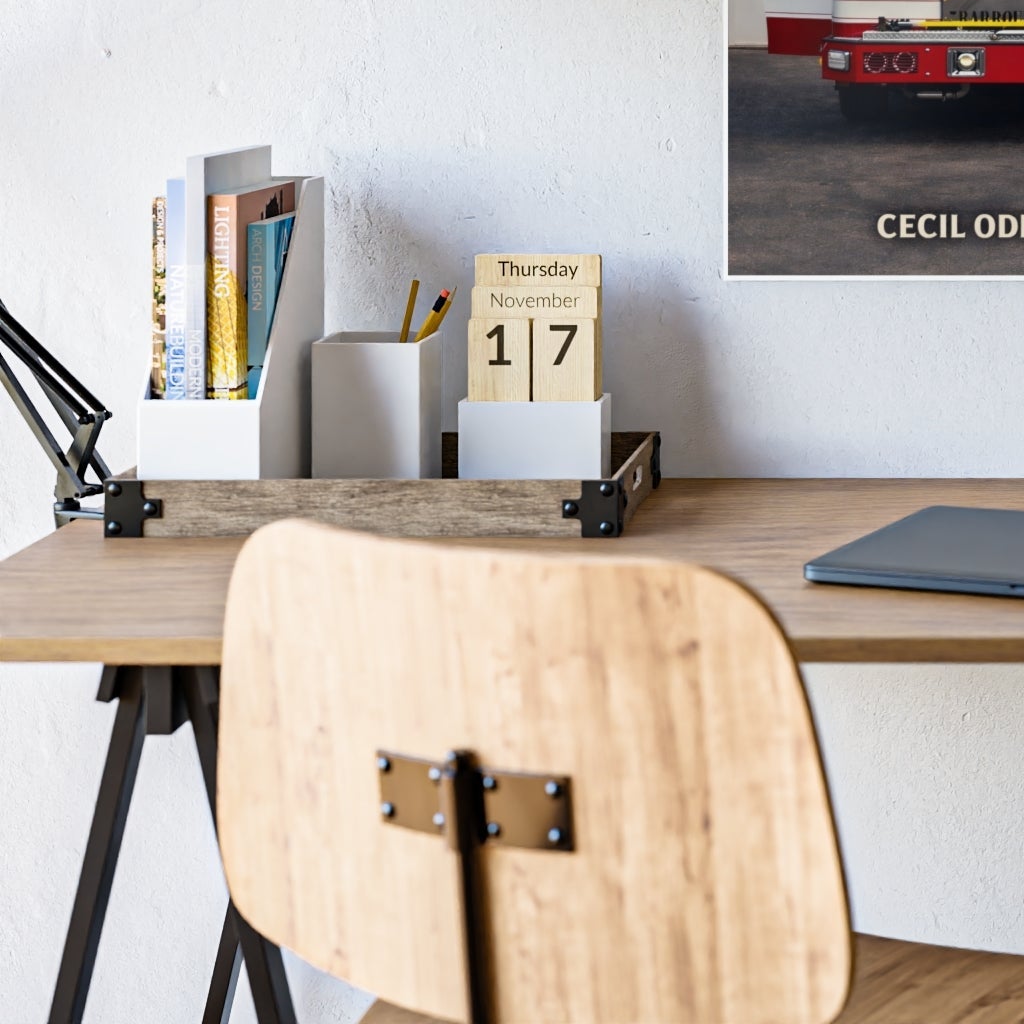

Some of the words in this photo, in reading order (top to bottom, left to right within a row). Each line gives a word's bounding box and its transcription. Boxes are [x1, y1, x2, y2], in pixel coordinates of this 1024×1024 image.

[876, 212, 966, 240] CECIL
[213, 205, 230, 299] LIGHTING
[251, 229, 263, 263] ARCH
[497, 260, 579, 280] Thursday
[251, 265, 263, 312] DESIGN
[490, 292, 580, 309] November
[188, 329, 202, 399] MODERN
